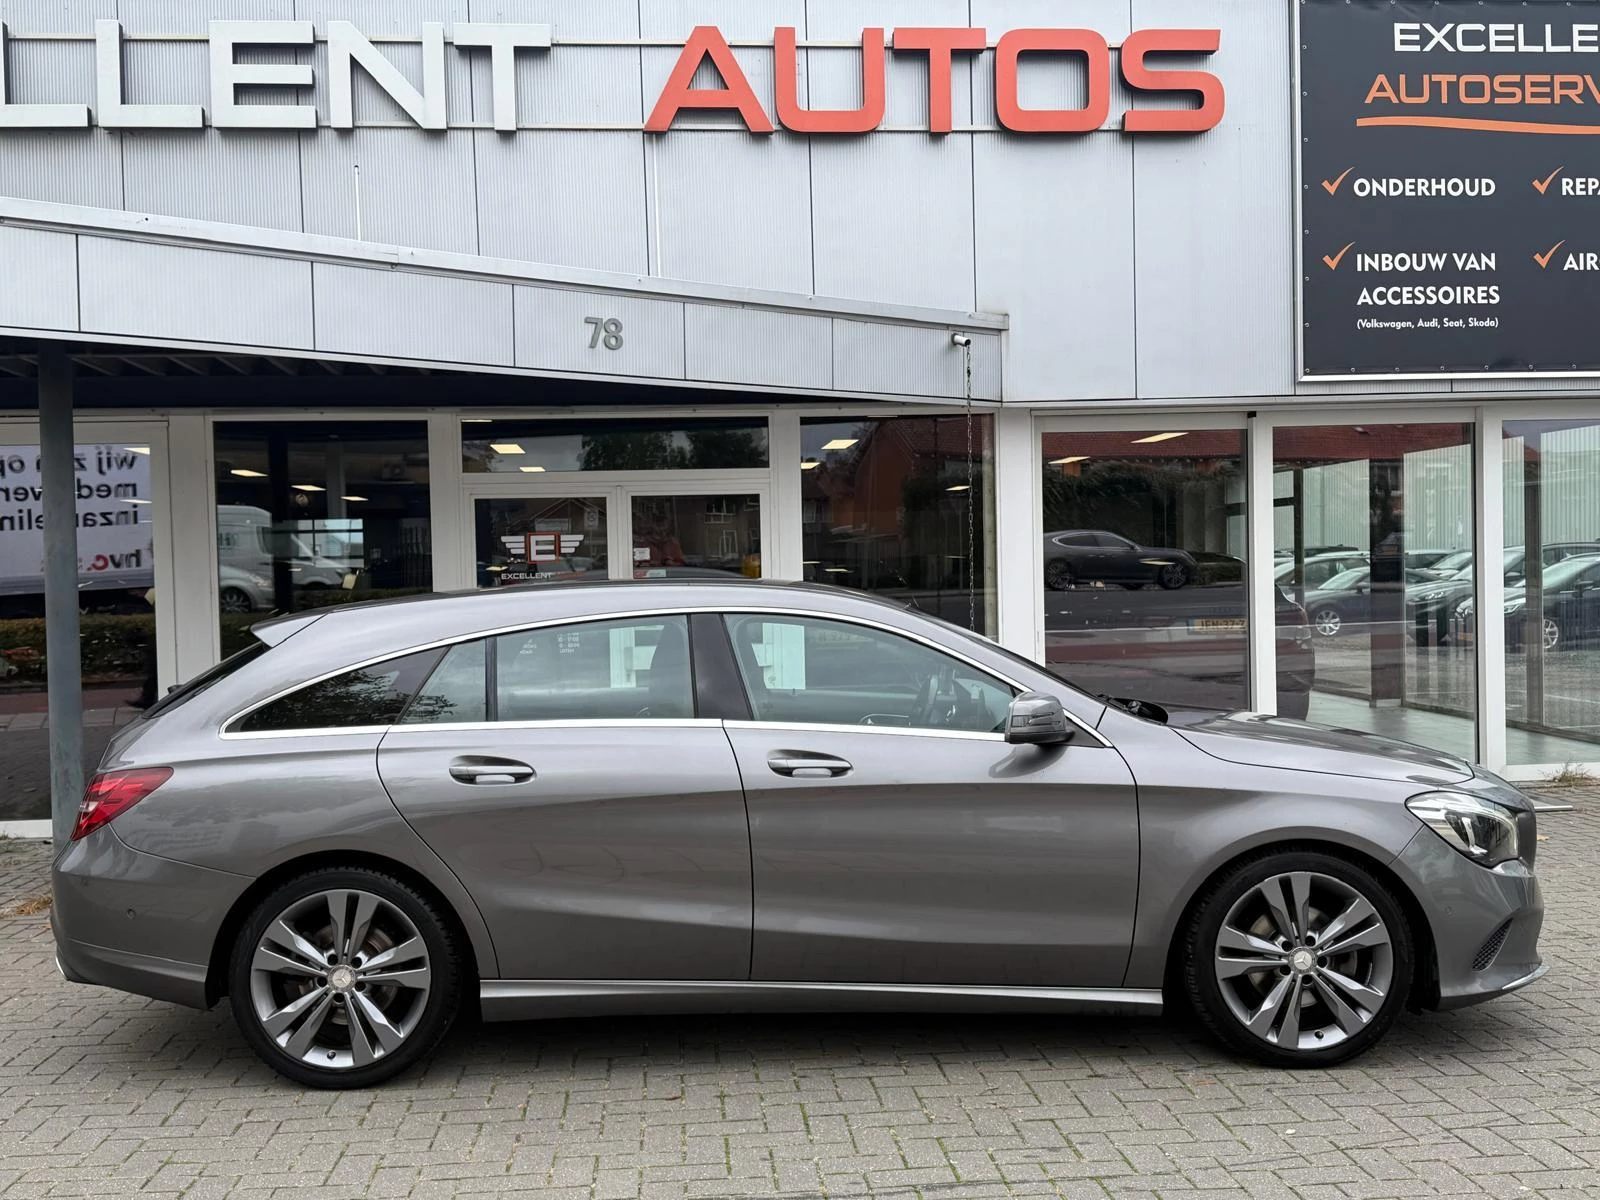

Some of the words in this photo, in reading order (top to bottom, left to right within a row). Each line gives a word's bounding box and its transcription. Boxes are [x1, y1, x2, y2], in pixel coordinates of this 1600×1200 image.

[1393, 22, 1599, 52] EXCELLE
[643, 26, 1225, 134] AUTOS
[1353, 178, 1496, 197] ONDERHOUD
[1561, 177, 1600, 196] REP
[1356, 253, 1447, 272] INBOUW
[1452, 252, 1496, 271] VAN
[1563, 252, 1600, 271] AIR
[1356, 286, 1500, 305] ACCESSOIRES
[584, 316, 624, 350] 78
[1357, 318, 1415, 330] (Volkswagen,
[1417, 317, 1441, 329] Audi,
[1443, 317, 1466, 328] Seat,
[1468, 317, 1499, 328] Skoda)
[501, 572, 552, 580] EXCELLENT
